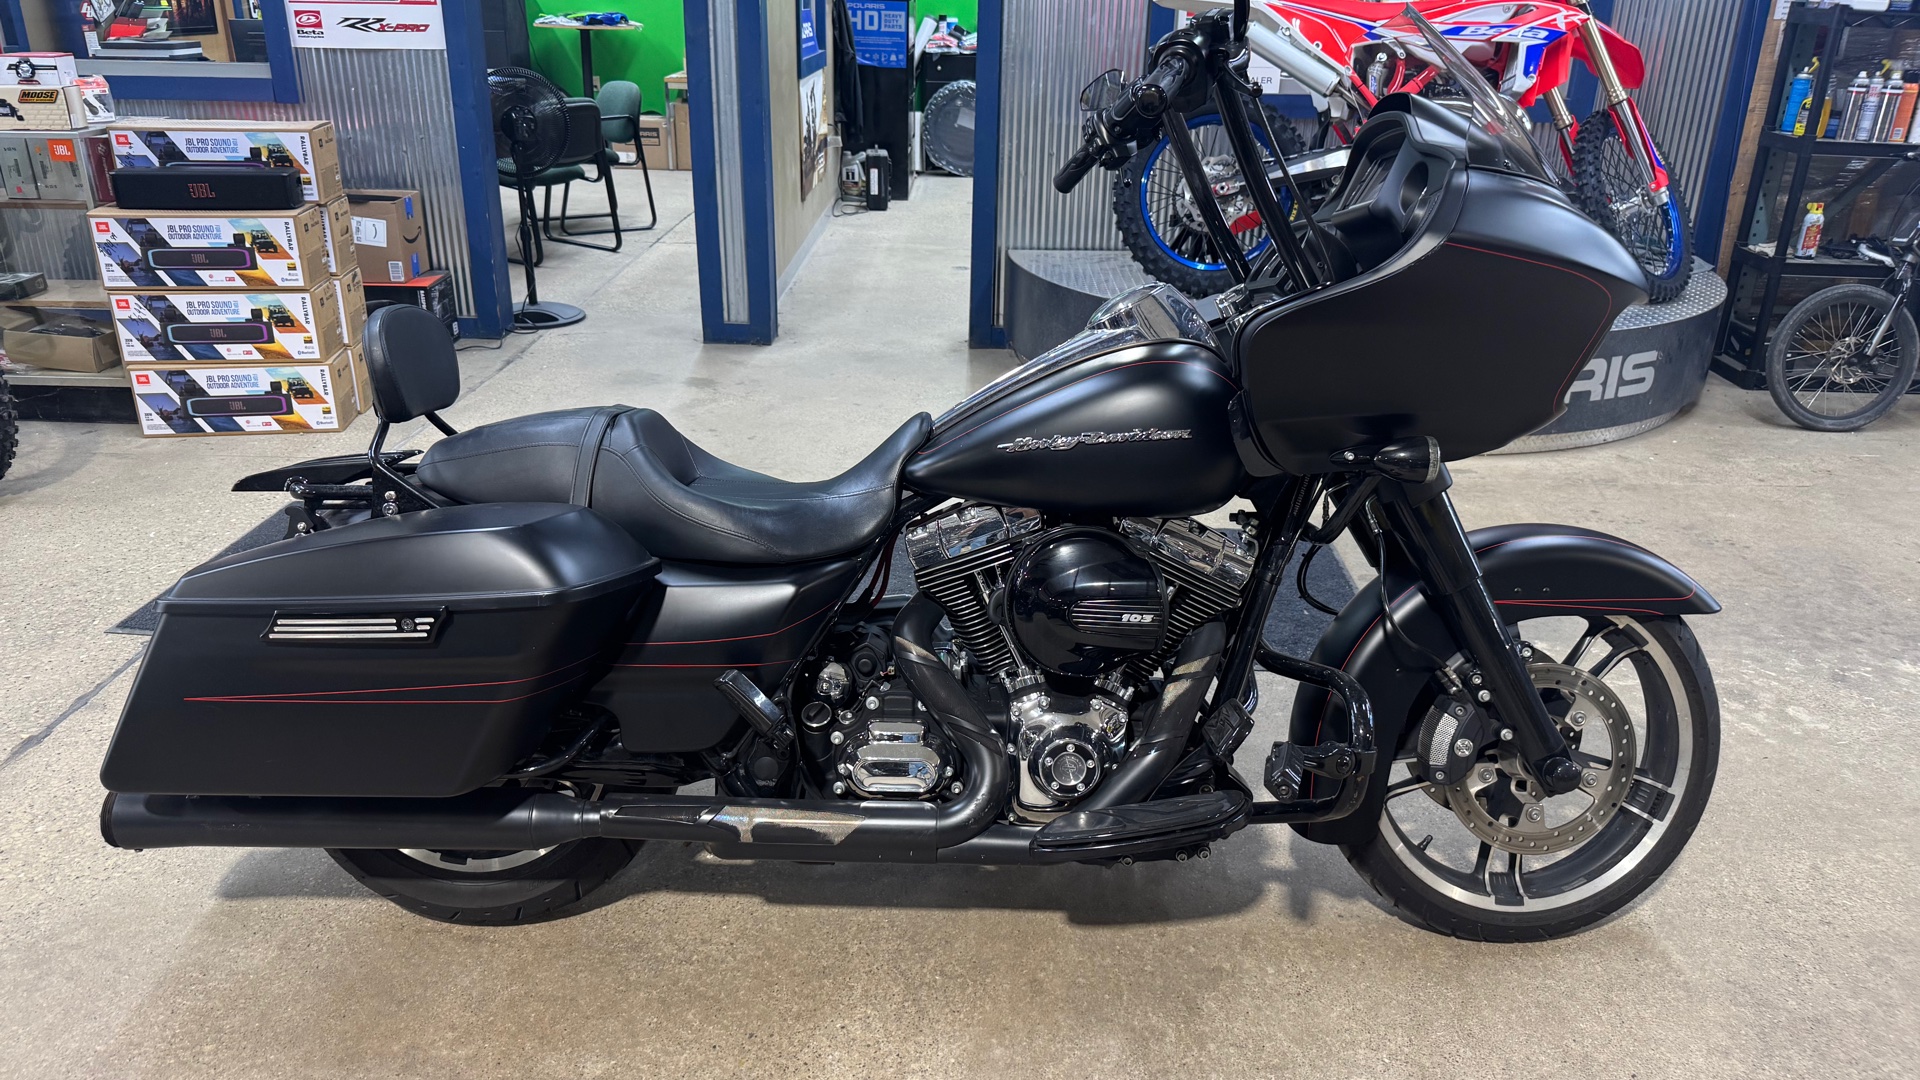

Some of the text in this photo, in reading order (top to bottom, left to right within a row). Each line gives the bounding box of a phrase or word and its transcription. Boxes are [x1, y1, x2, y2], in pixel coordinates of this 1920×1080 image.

[849, 10, 879, 30] HD
[377, 23, 431, 33] X-PRO
[1459, 25, 1550, 40] Beta
[21, 91, 56, 99] MOOSE
[185, 138, 196, 146] JBL
[196, 138, 210, 146] PRO
[210, 137, 232, 146] SOUND
[53, 145, 71, 156] JBL
[300, 135, 310, 166] RALLYBAR
[187, 183, 216, 198] JBL
[167, 224, 178, 232] JBL
[178, 224, 192, 232] PRO
[192, 224, 214, 232] SOUND
[284, 221, 294, 251] RALLYBAR
[191, 254, 209, 264] JBL
[211, 300, 232, 308] SOUND
[300, 296, 310, 325] RALLYBAR
[209, 328, 227, 338] JBL
[230, 374, 252, 382] SOUND
[320, 368, 329, 396] RALLYBAR
[229, 401, 246, 410] JBL
[1000, 428, 1193, 453] Harley-Davidson
[1121, 613, 1155, 623] 103
